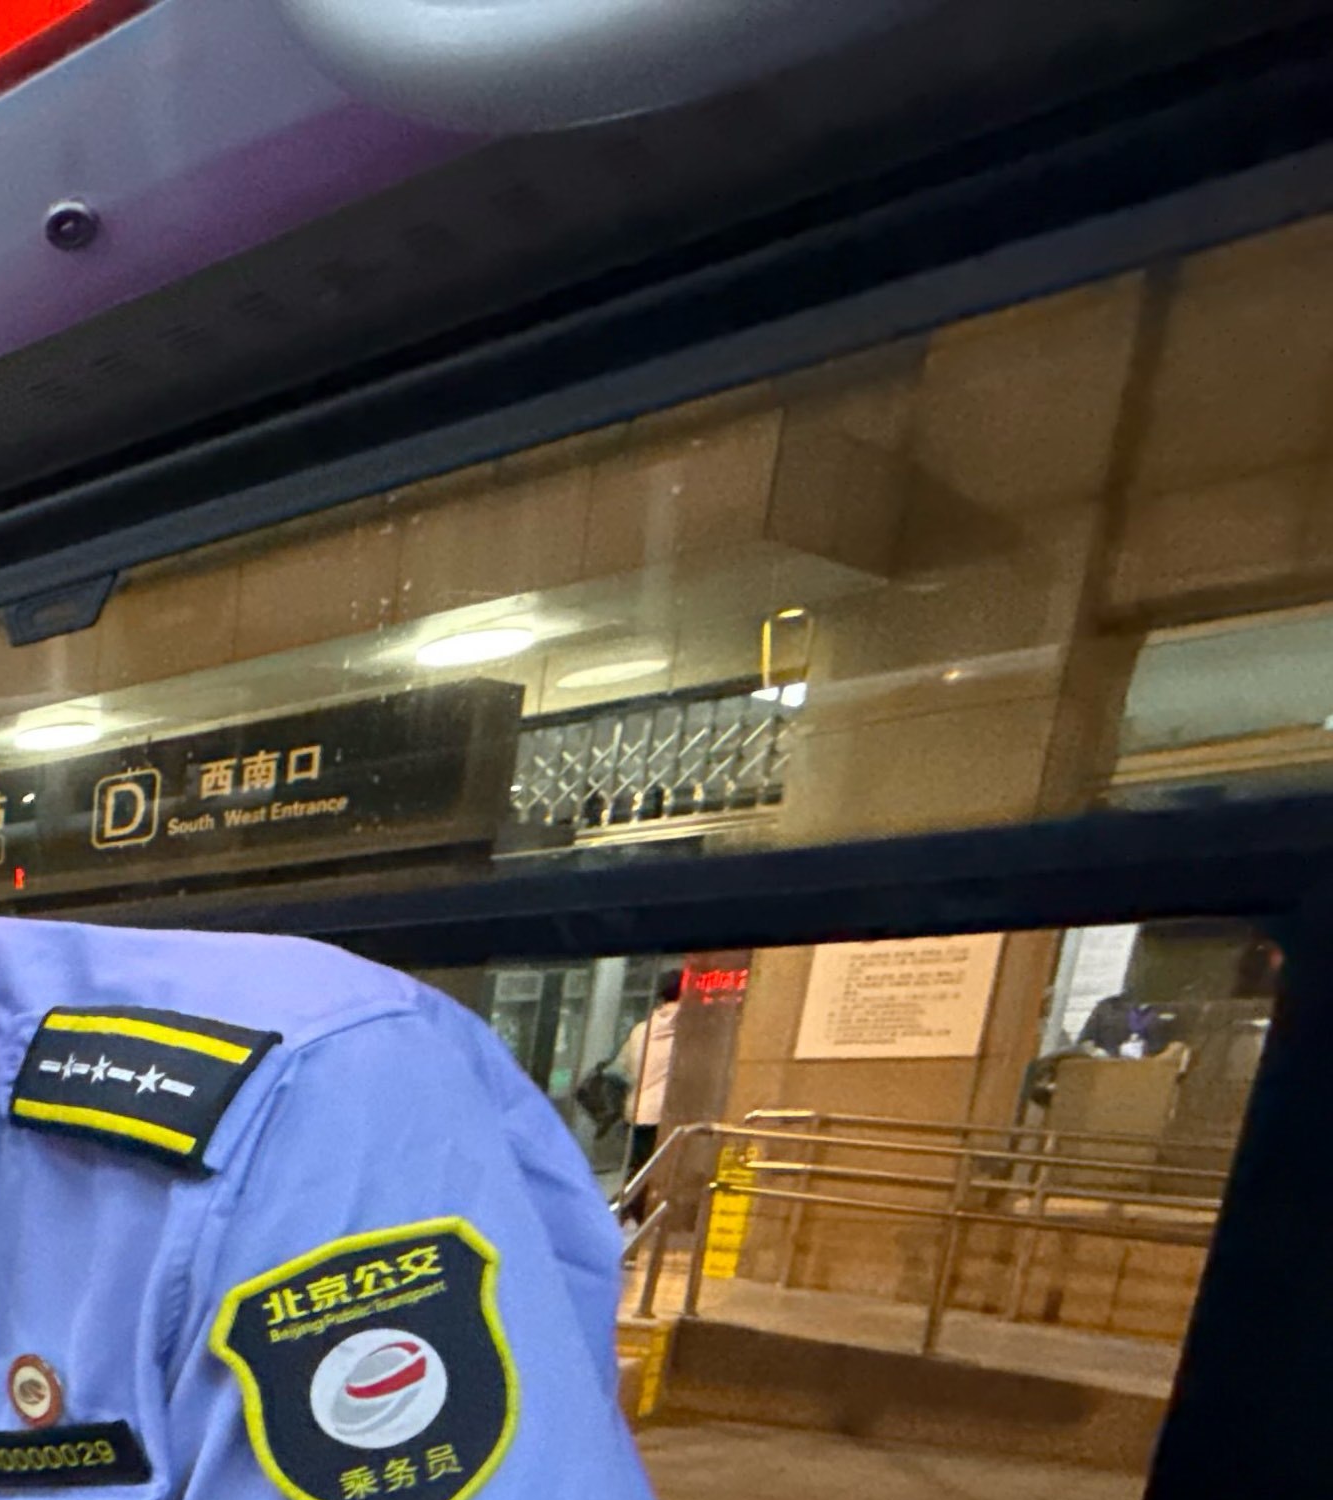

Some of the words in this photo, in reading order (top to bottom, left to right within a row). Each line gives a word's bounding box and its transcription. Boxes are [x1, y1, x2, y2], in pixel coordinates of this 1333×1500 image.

[199, 745, 322, 799] 西南口
[104, 782, 145, 839] D
[167, 814, 215, 836] South
[224, 807, 267, 828] West
[270, 796, 349, 821] Entrance
[262, 1245, 443, 1326] 北京公交
[339, 1443, 463, 1500] 乘务员
